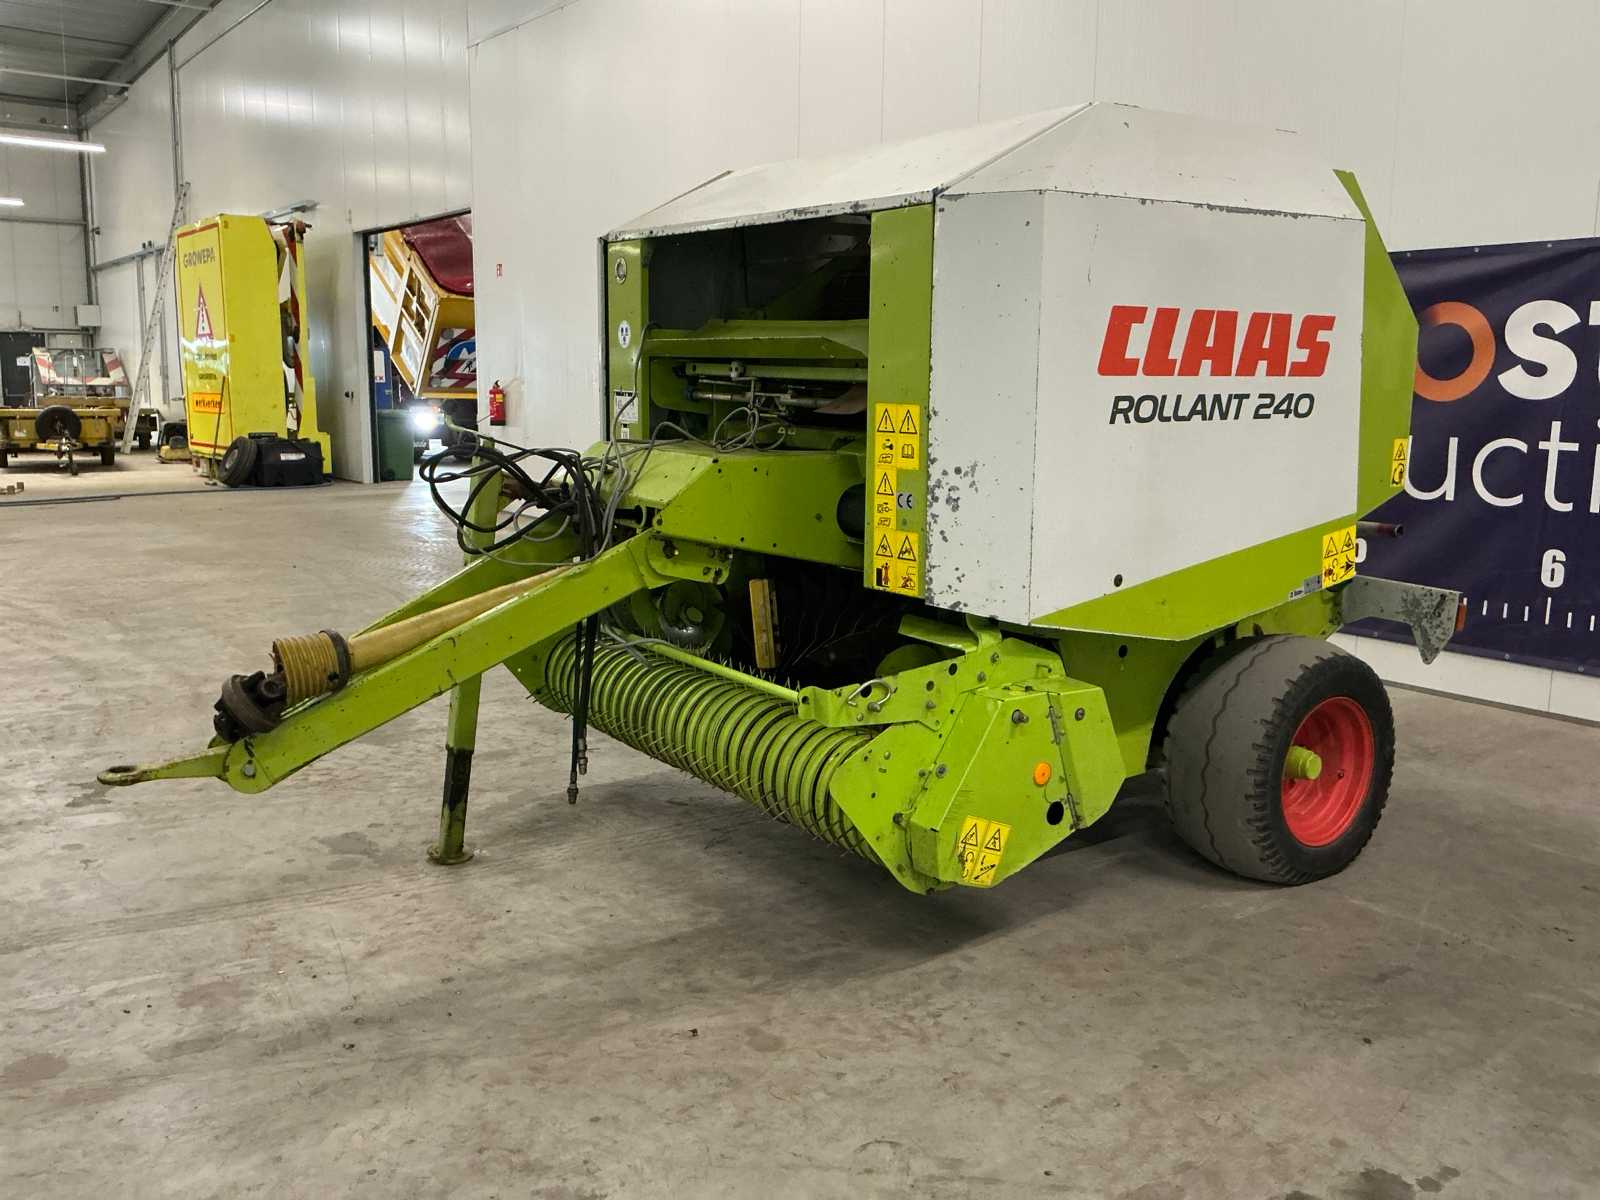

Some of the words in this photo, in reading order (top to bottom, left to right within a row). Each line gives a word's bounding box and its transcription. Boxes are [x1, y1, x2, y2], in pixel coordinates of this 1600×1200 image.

[183, 247, 216, 269] GROWEPA
[1097, 305, 1336, 377] CLAAS
[1109, 393, 1250, 425] ROLLANT
[1253, 392, 1315, 420] 240
[897, 493, 913, 509] CE
[1541, 548, 1566, 588] 6
